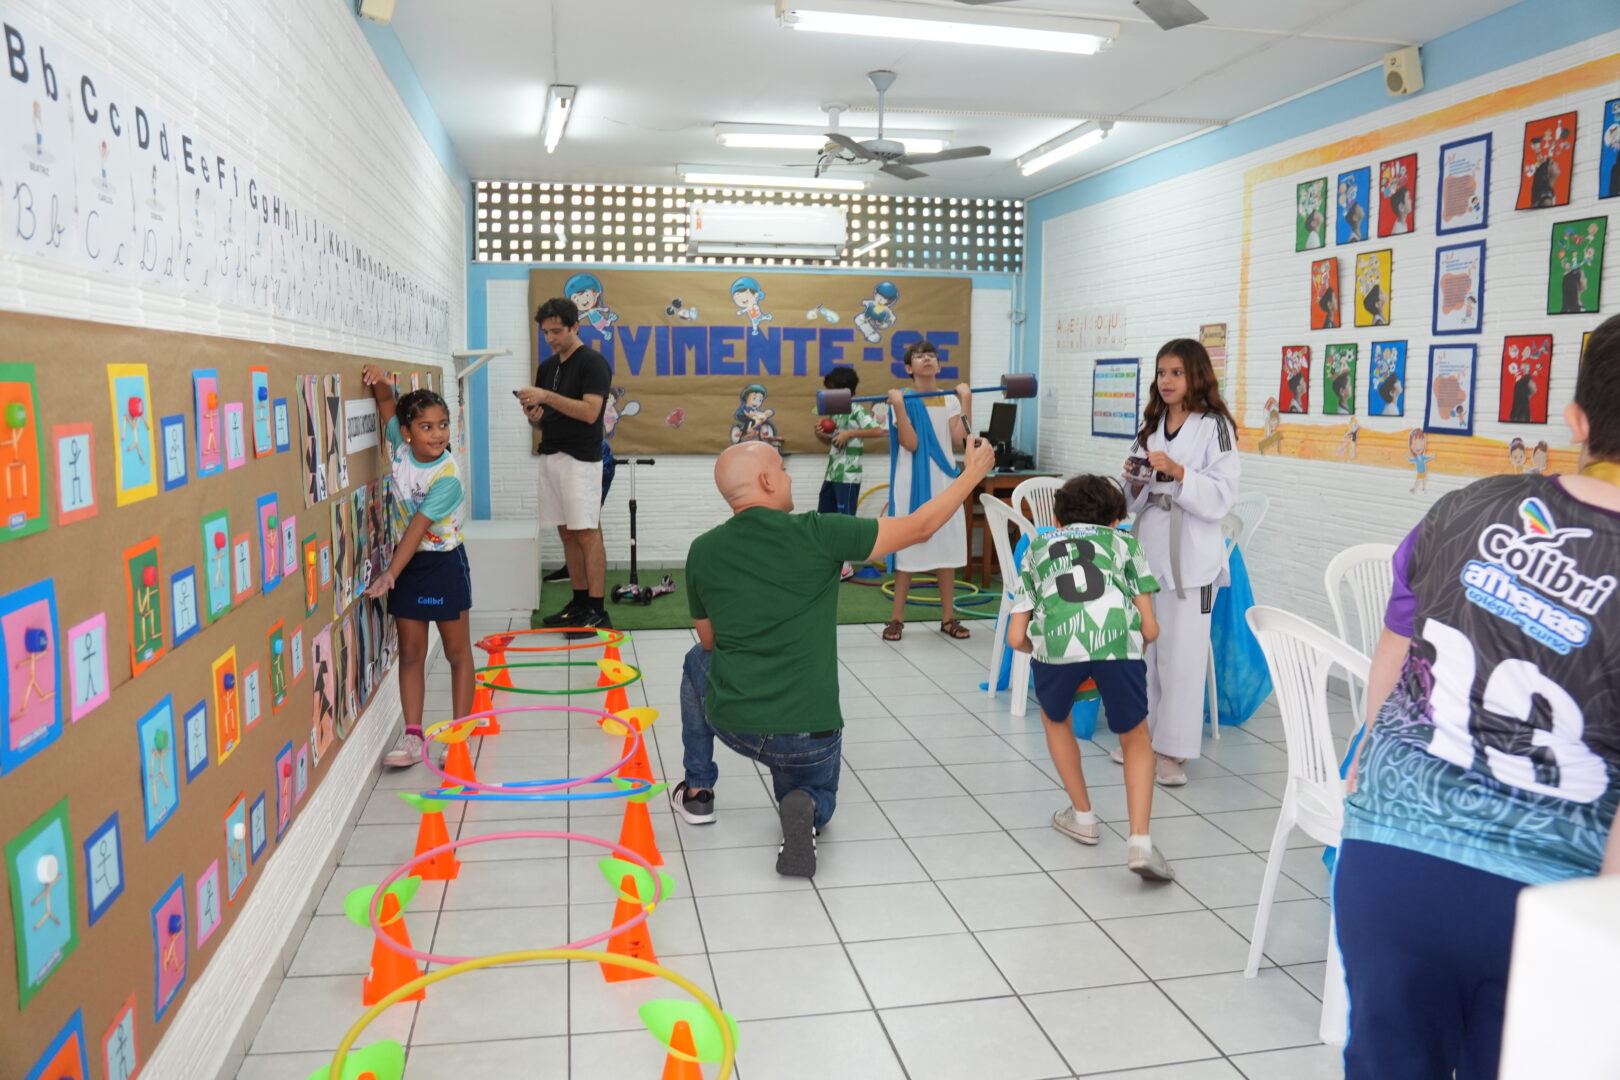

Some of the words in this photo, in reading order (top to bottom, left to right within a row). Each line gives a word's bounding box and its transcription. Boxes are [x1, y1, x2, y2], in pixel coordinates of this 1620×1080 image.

[4, 22, 29, 83] B
[40, 45, 58, 101] b
[81, 75, 98, 124] C
[110, 103, 121, 137] c
[136, 105, 149, 149] D
[160, 122, 170, 162] d
[182, 134, 195, 174] E
[217, 155, 225, 190] F
[538, 325, 958, 378] OVIMENTE-SE
[1048, 538, 1105, 603] 3
[1461, 560, 1591, 646] athenas
[1479, 524, 1617, 614] Colibri
[1530, 625, 1569, 652] curso
[1422, 617, 1610, 804] 13
